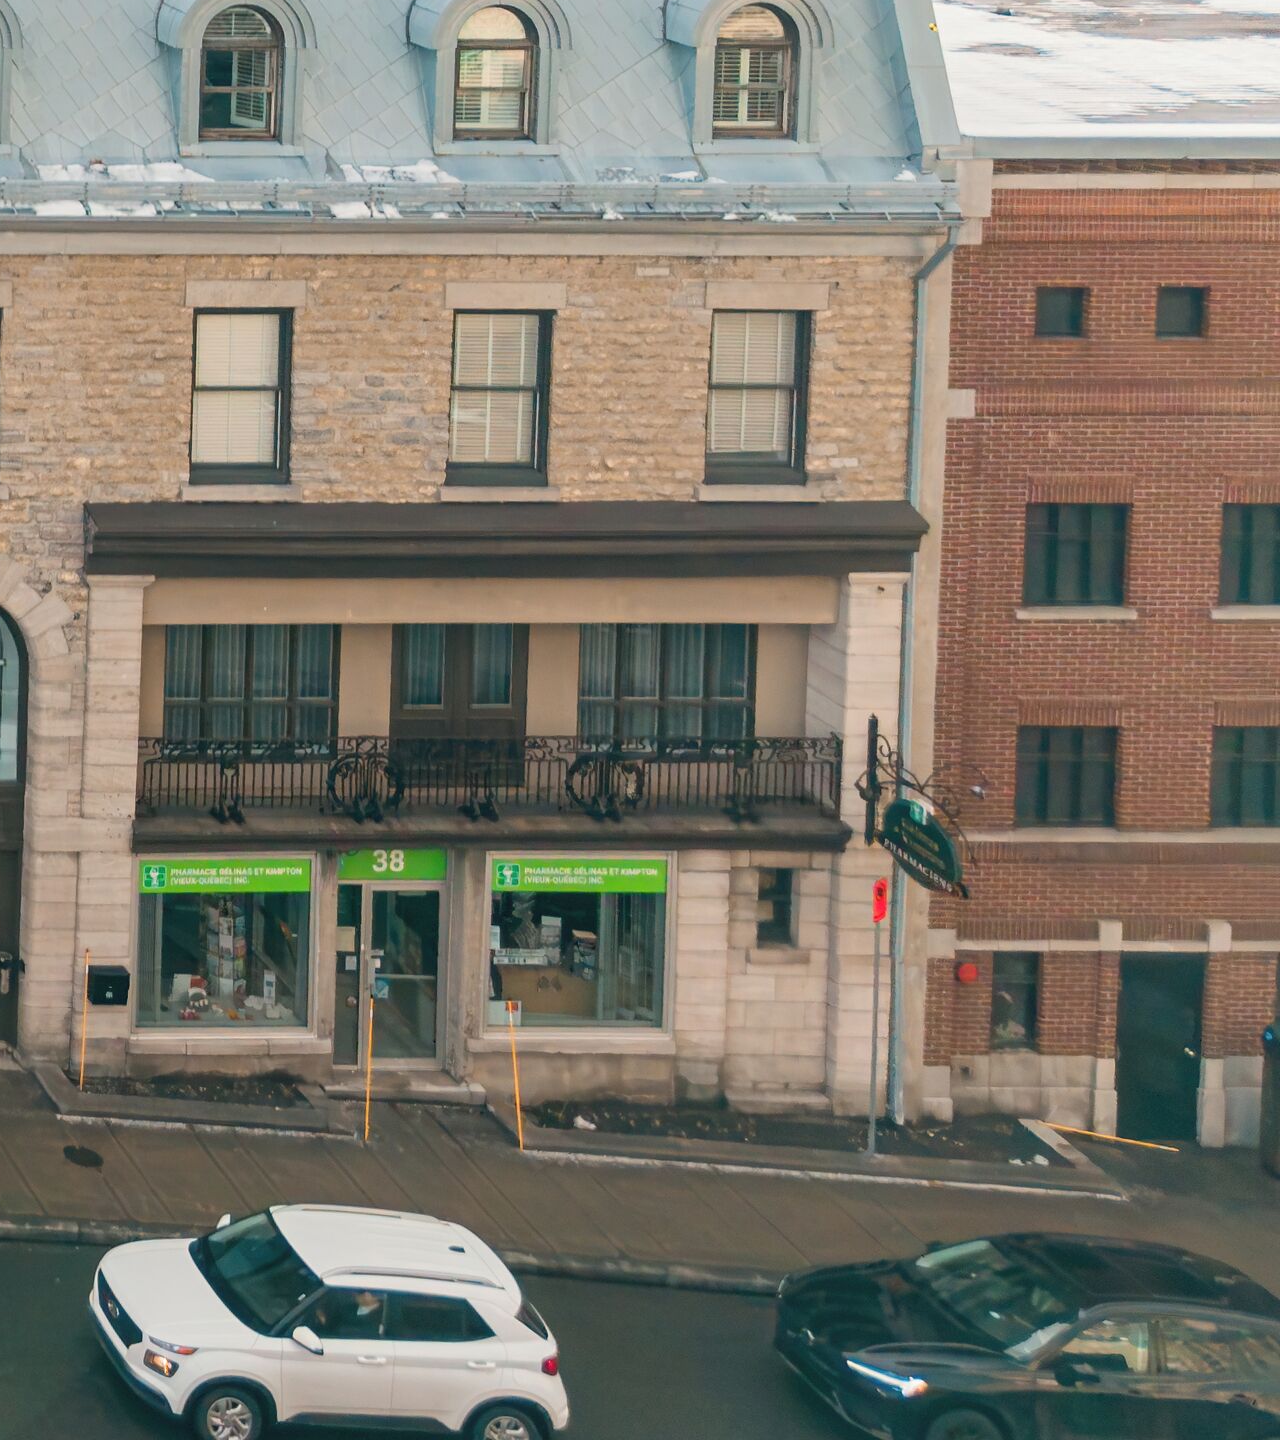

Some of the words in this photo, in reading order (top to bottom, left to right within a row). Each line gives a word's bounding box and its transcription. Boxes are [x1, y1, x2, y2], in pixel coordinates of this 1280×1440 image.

[372, 849, 405, 872] 38
[170, 868, 217, 876] PHARMACIE
[254, 867, 263, 875] ET
[524, 867, 571, 875] PHARMACIE
[610, 867, 619, 875] ET
